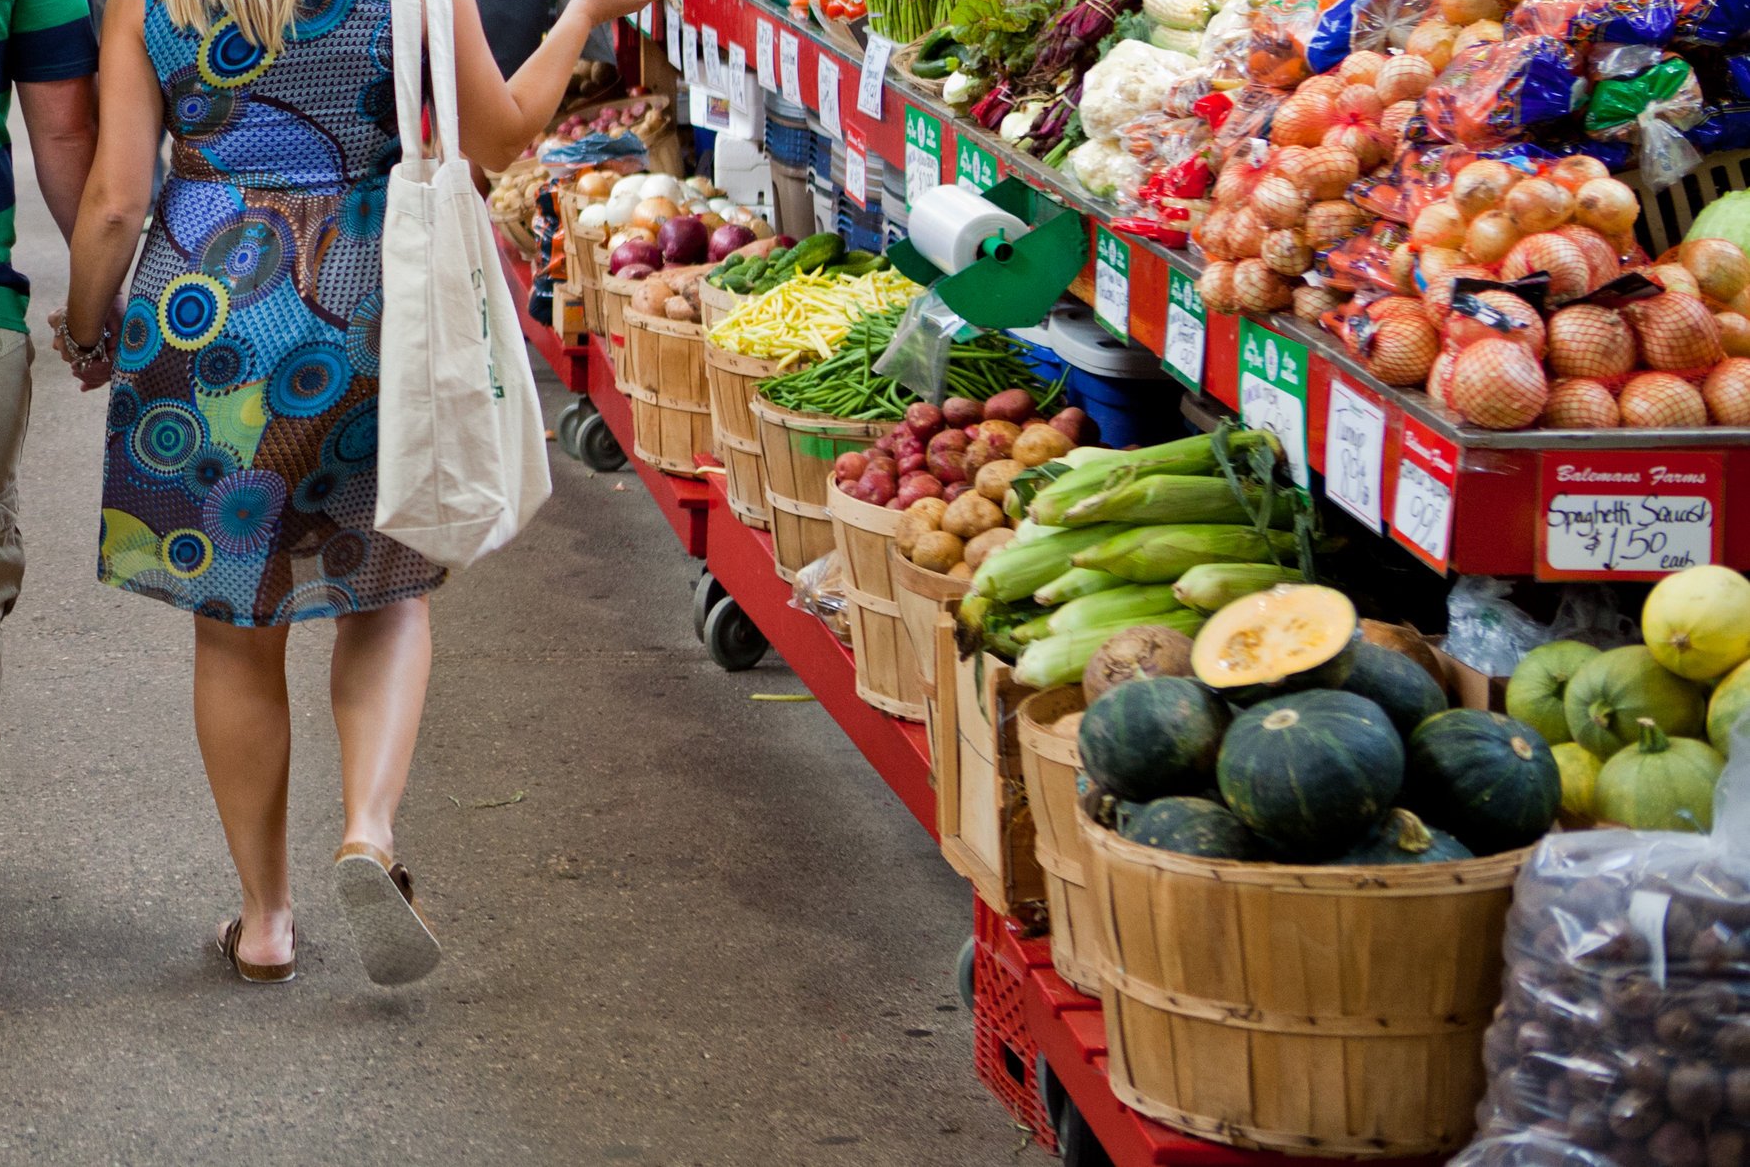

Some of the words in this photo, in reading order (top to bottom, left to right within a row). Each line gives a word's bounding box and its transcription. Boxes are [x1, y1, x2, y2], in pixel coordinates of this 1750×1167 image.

[1556, 465, 1642, 482] Balemans
[1648, 466, 1707, 486] Farms
[1546, 493, 1632, 537] Spaghetti
[1660, 550, 1696, 570] each
